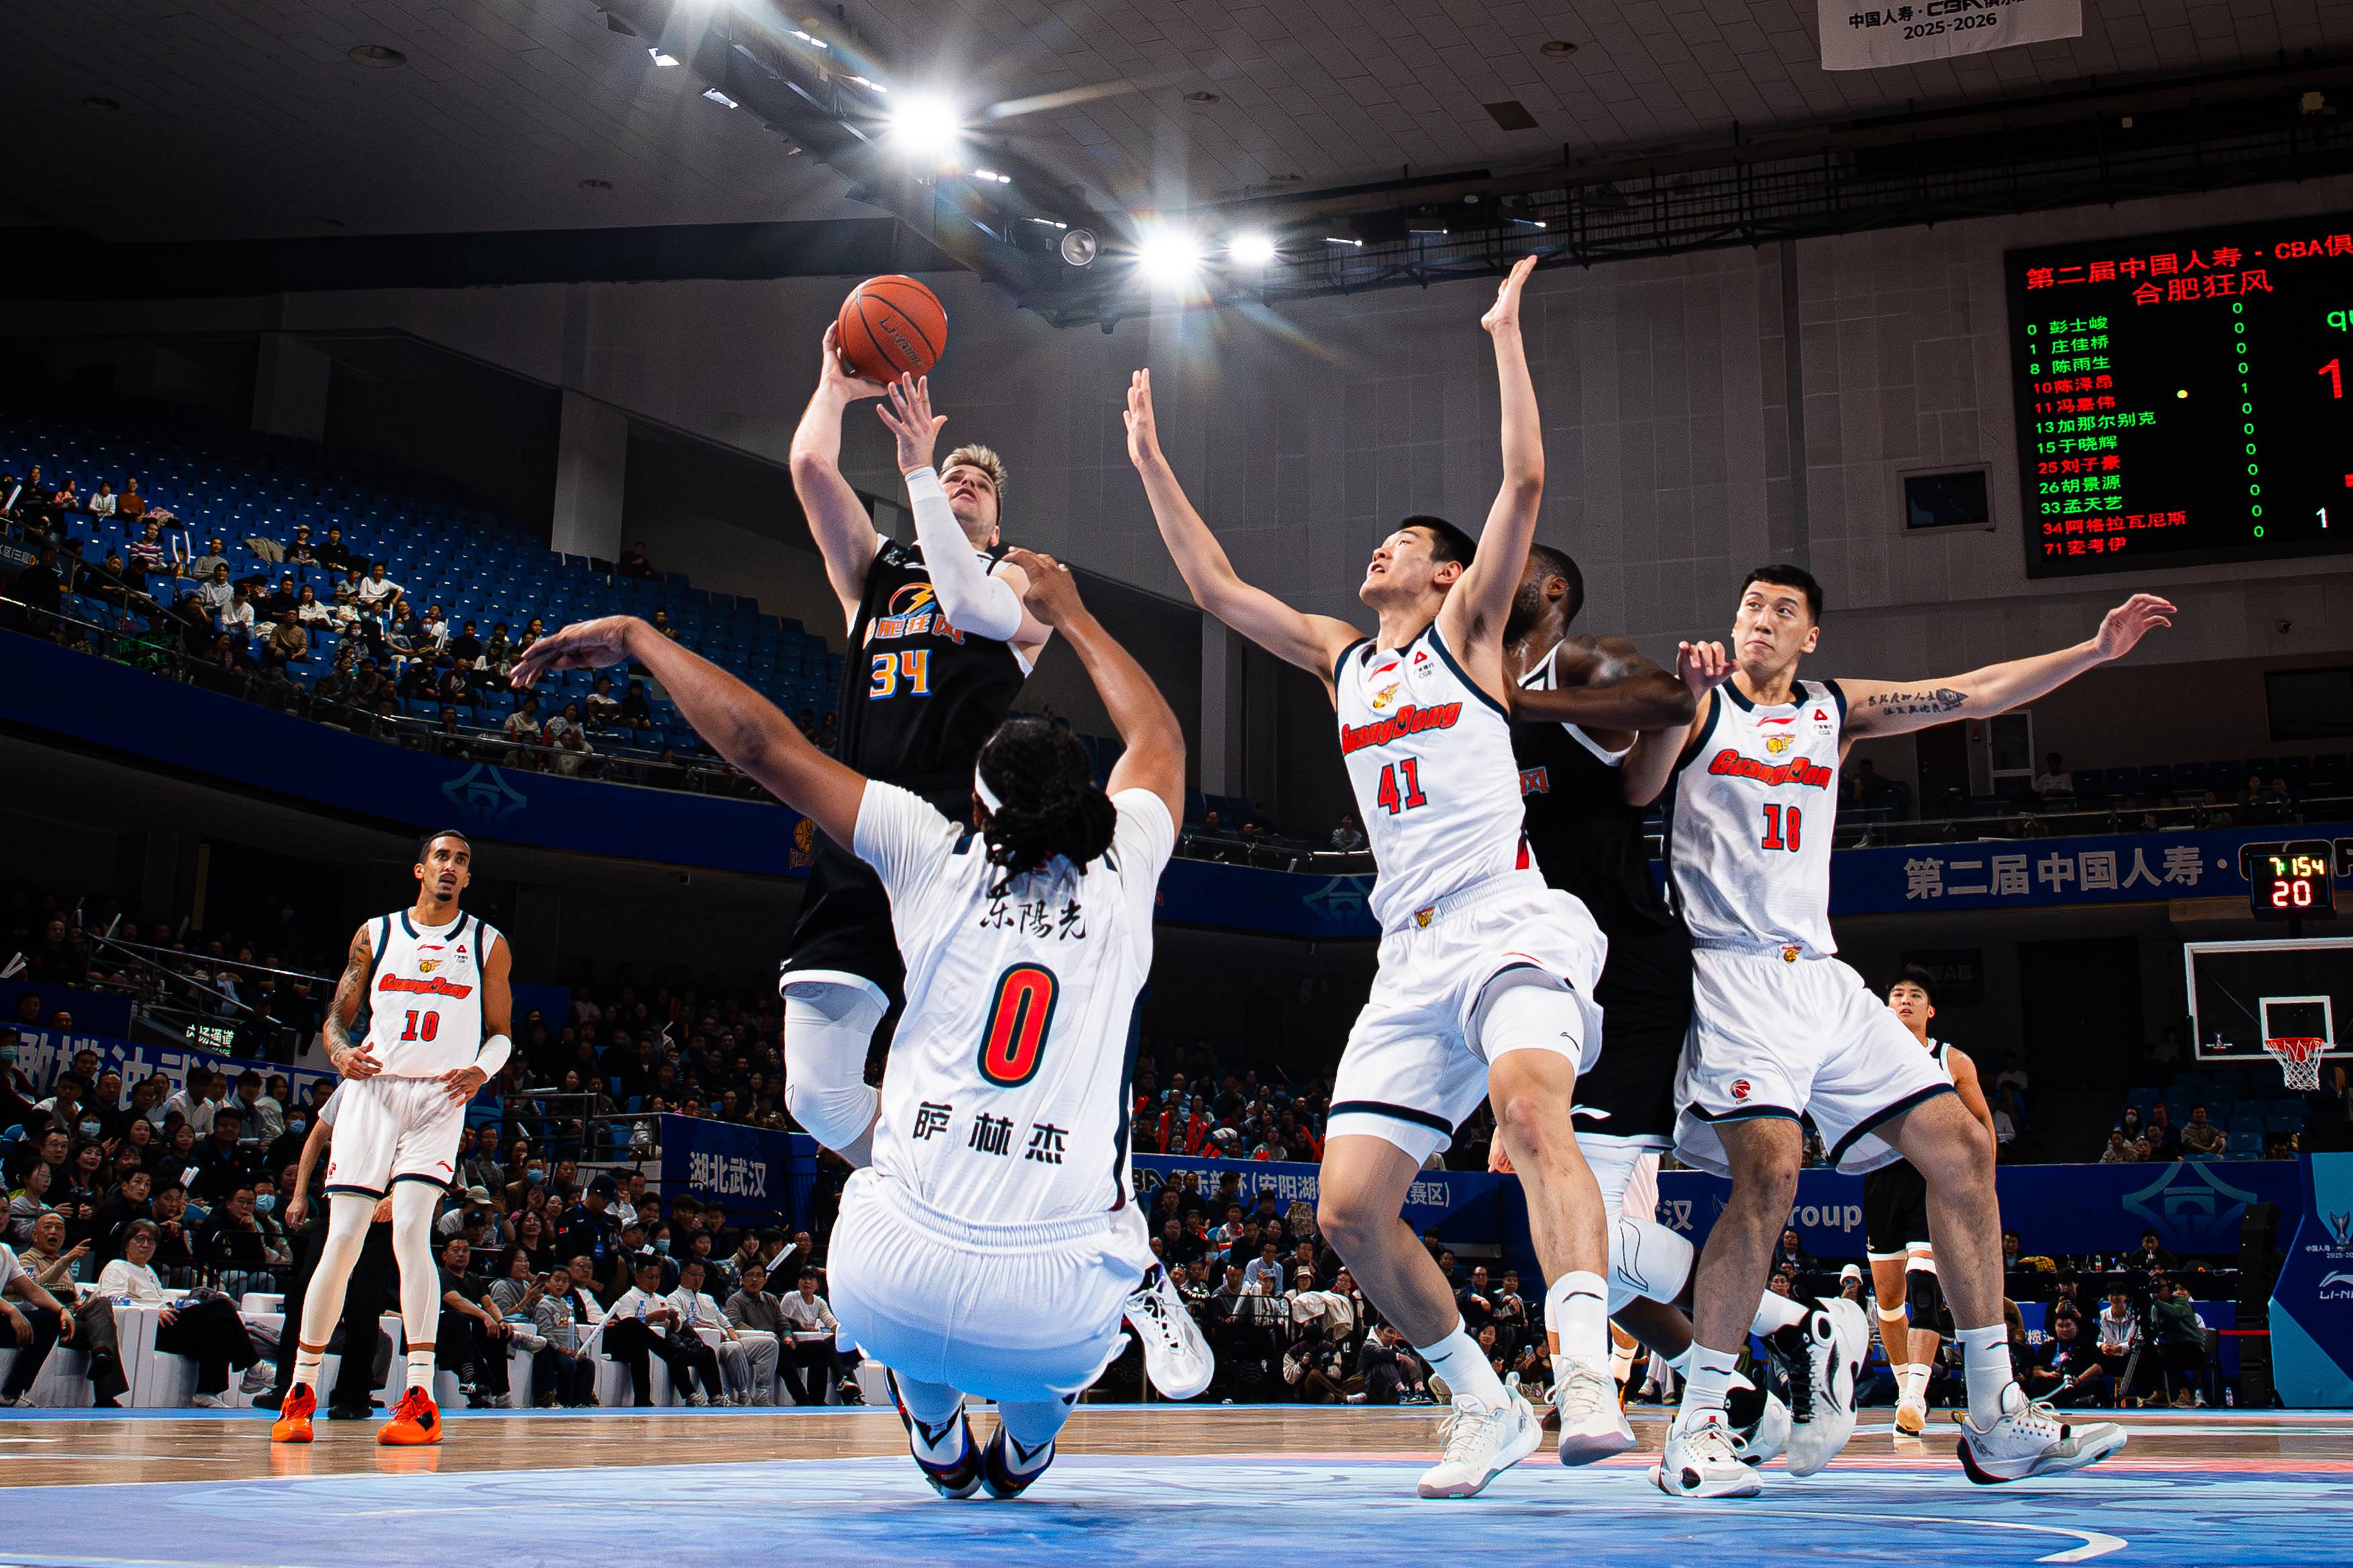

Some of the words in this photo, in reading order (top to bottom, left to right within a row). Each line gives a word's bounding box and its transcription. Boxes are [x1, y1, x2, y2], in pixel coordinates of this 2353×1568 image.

[1903, 13, 1997, 40] 2025-2026
[2132, 270, 2274, 306] 合肥狂风
[2026, 324, 2037, 335] 0
[2048, 316, 2109, 335] 彭士峻
[2232, 302, 2242, 313] 0
[2030, 344, 2036, 355] 1
[2051, 335, 2110, 354] 庄佳桥
[2234, 323, 2244, 333] 0
[2030, 363, 2040, 375] 8
[2052, 356, 2111, 374] 陈雨生
[2236, 343, 2246, 354] 0
[2033, 382, 2052, 394] 10
[2238, 363, 2248, 374] 0
[2034, 403, 2051, 414] 11
[2241, 383, 2247, 394] 1
[2036, 422, 2055, 434] 13
[2057, 411, 2156, 433] 加那尔别克
[2242, 403, 2252, 413] 0
[2037, 442, 2056, 454] 15
[2058, 436, 2118, 453] 于晓辉
[2244, 423, 2254, 434] 0
[2038, 462, 2058, 474] 25
[2246, 444, 2256, 454] 0
[2039, 482, 2059, 494] 26
[2061, 475, 2122, 493] 胡景源
[2247, 464, 2258, 475] 0
[2041, 502, 2061, 513] 33
[2063, 496, 2123, 513] 孟天艺
[2249, 485, 2260, 495] 0
[2043, 523, 2063, 535] 34
[2065, 511, 2186, 534] 阿格拉瓦尼斯
[2251, 505, 2262, 516] 0
[2316, 507, 2328, 528] 1
[2044, 543, 2062, 556] 71
[2254, 526, 2264, 537] 0
[870, 649, 932, 700] 34
[1378, 756, 1426, 816] 41
[1760, 802, 1802, 854] 18
[2272, 880, 2311, 907] 20
[401, 1009, 440, 1042] 10
[976, 961, 1060, 1089] 0
[912, 1100, 1069, 1165] 萨林杰
[689, 1151, 766, 1198] 湖北武汉
[1405, 1181, 1449, 1207] 赛区)
[1788, 1206, 1862, 1233] roup
